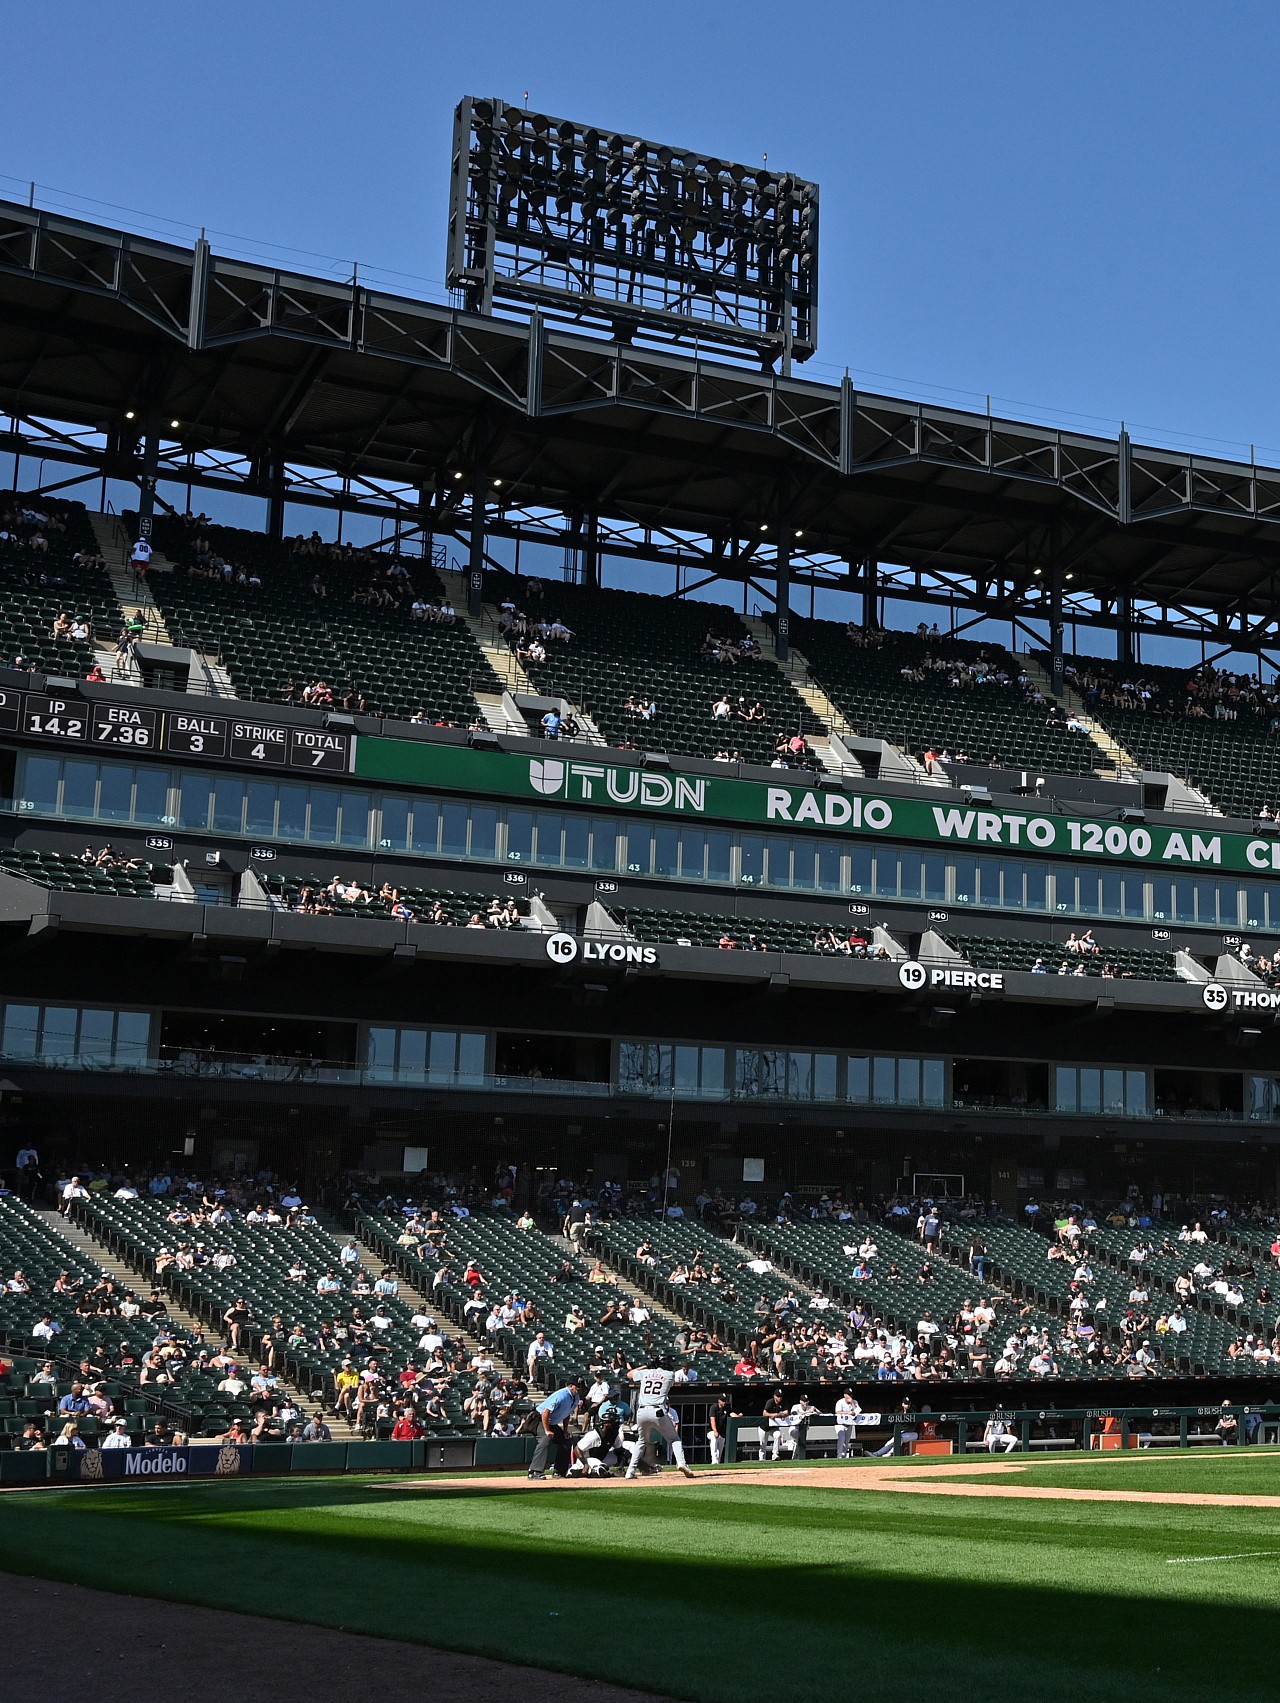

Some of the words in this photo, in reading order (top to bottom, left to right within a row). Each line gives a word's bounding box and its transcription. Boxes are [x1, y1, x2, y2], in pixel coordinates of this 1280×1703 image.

[49, 701, 66, 714] IP
[108, 709, 142, 725] ERA
[30, 716, 82, 737] 14.2
[177, 717, 219, 735] BALL
[97, 724, 149, 745] 7.36
[234, 725, 284, 743] STRIKE
[190, 736, 204, 752] 3
[295, 733, 344, 751] TOTAL
[251, 744, 266, 760] 4
[311, 751, 325, 766] 7
[571, 764, 705, 812] TUDN
[20, 801, 35, 810] 39
[161, 815, 176, 825] 40
[767, 787, 893, 830] RADIO
[932, 806, 1056, 848] WRTO
[1066, 820, 1152, 857] 1200
[1161, 832, 1222, 864] AM
[149, 838, 170, 848] 335
[380, 839, 391, 848] 41
[254, 849, 274, 859] 336
[508, 851, 521, 860] 42
[628, 863, 640, 872] 43
[506, 873, 524, 883] 336
[741, 874, 754, 883] 44
[598, 882, 616, 891] 338
[850, 884, 862, 893] 45
[957, 894, 968, 902] 46
[851, 905, 867, 913] 338
[1056, 903, 1067, 911] 47
[930, 912, 946, 920] 340
[1154, 911, 1165, 919] 48
[1248, 919, 1258, 927] 49
[1153, 930, 1168, 938] 340
[1225, 936, 1239, 945] 342
[552, 939, 573, 956] 16
[583, 941, 657, 963] LYONS
[903, 968, 921, 982] 19
[931, 968, 1003, 989] PIERCE
[1206, 989, 1225, 1003] 35
[495, 1078, 507, 1086] 35
[953, 1100, 963, 1108] 39
[1155, 1108, 1164, 1116] 41
[644, 1381, 663, 1395] 22
[1093, 1410, 1112, 1418] RUSH
[1204, 1407, 1223, 1415] RUSH
[895, 1415, 916, 1423] RUSH
[996, 1412, 1016, 1421] RUSH
[125, 1453, 187, 1475] Modelo
